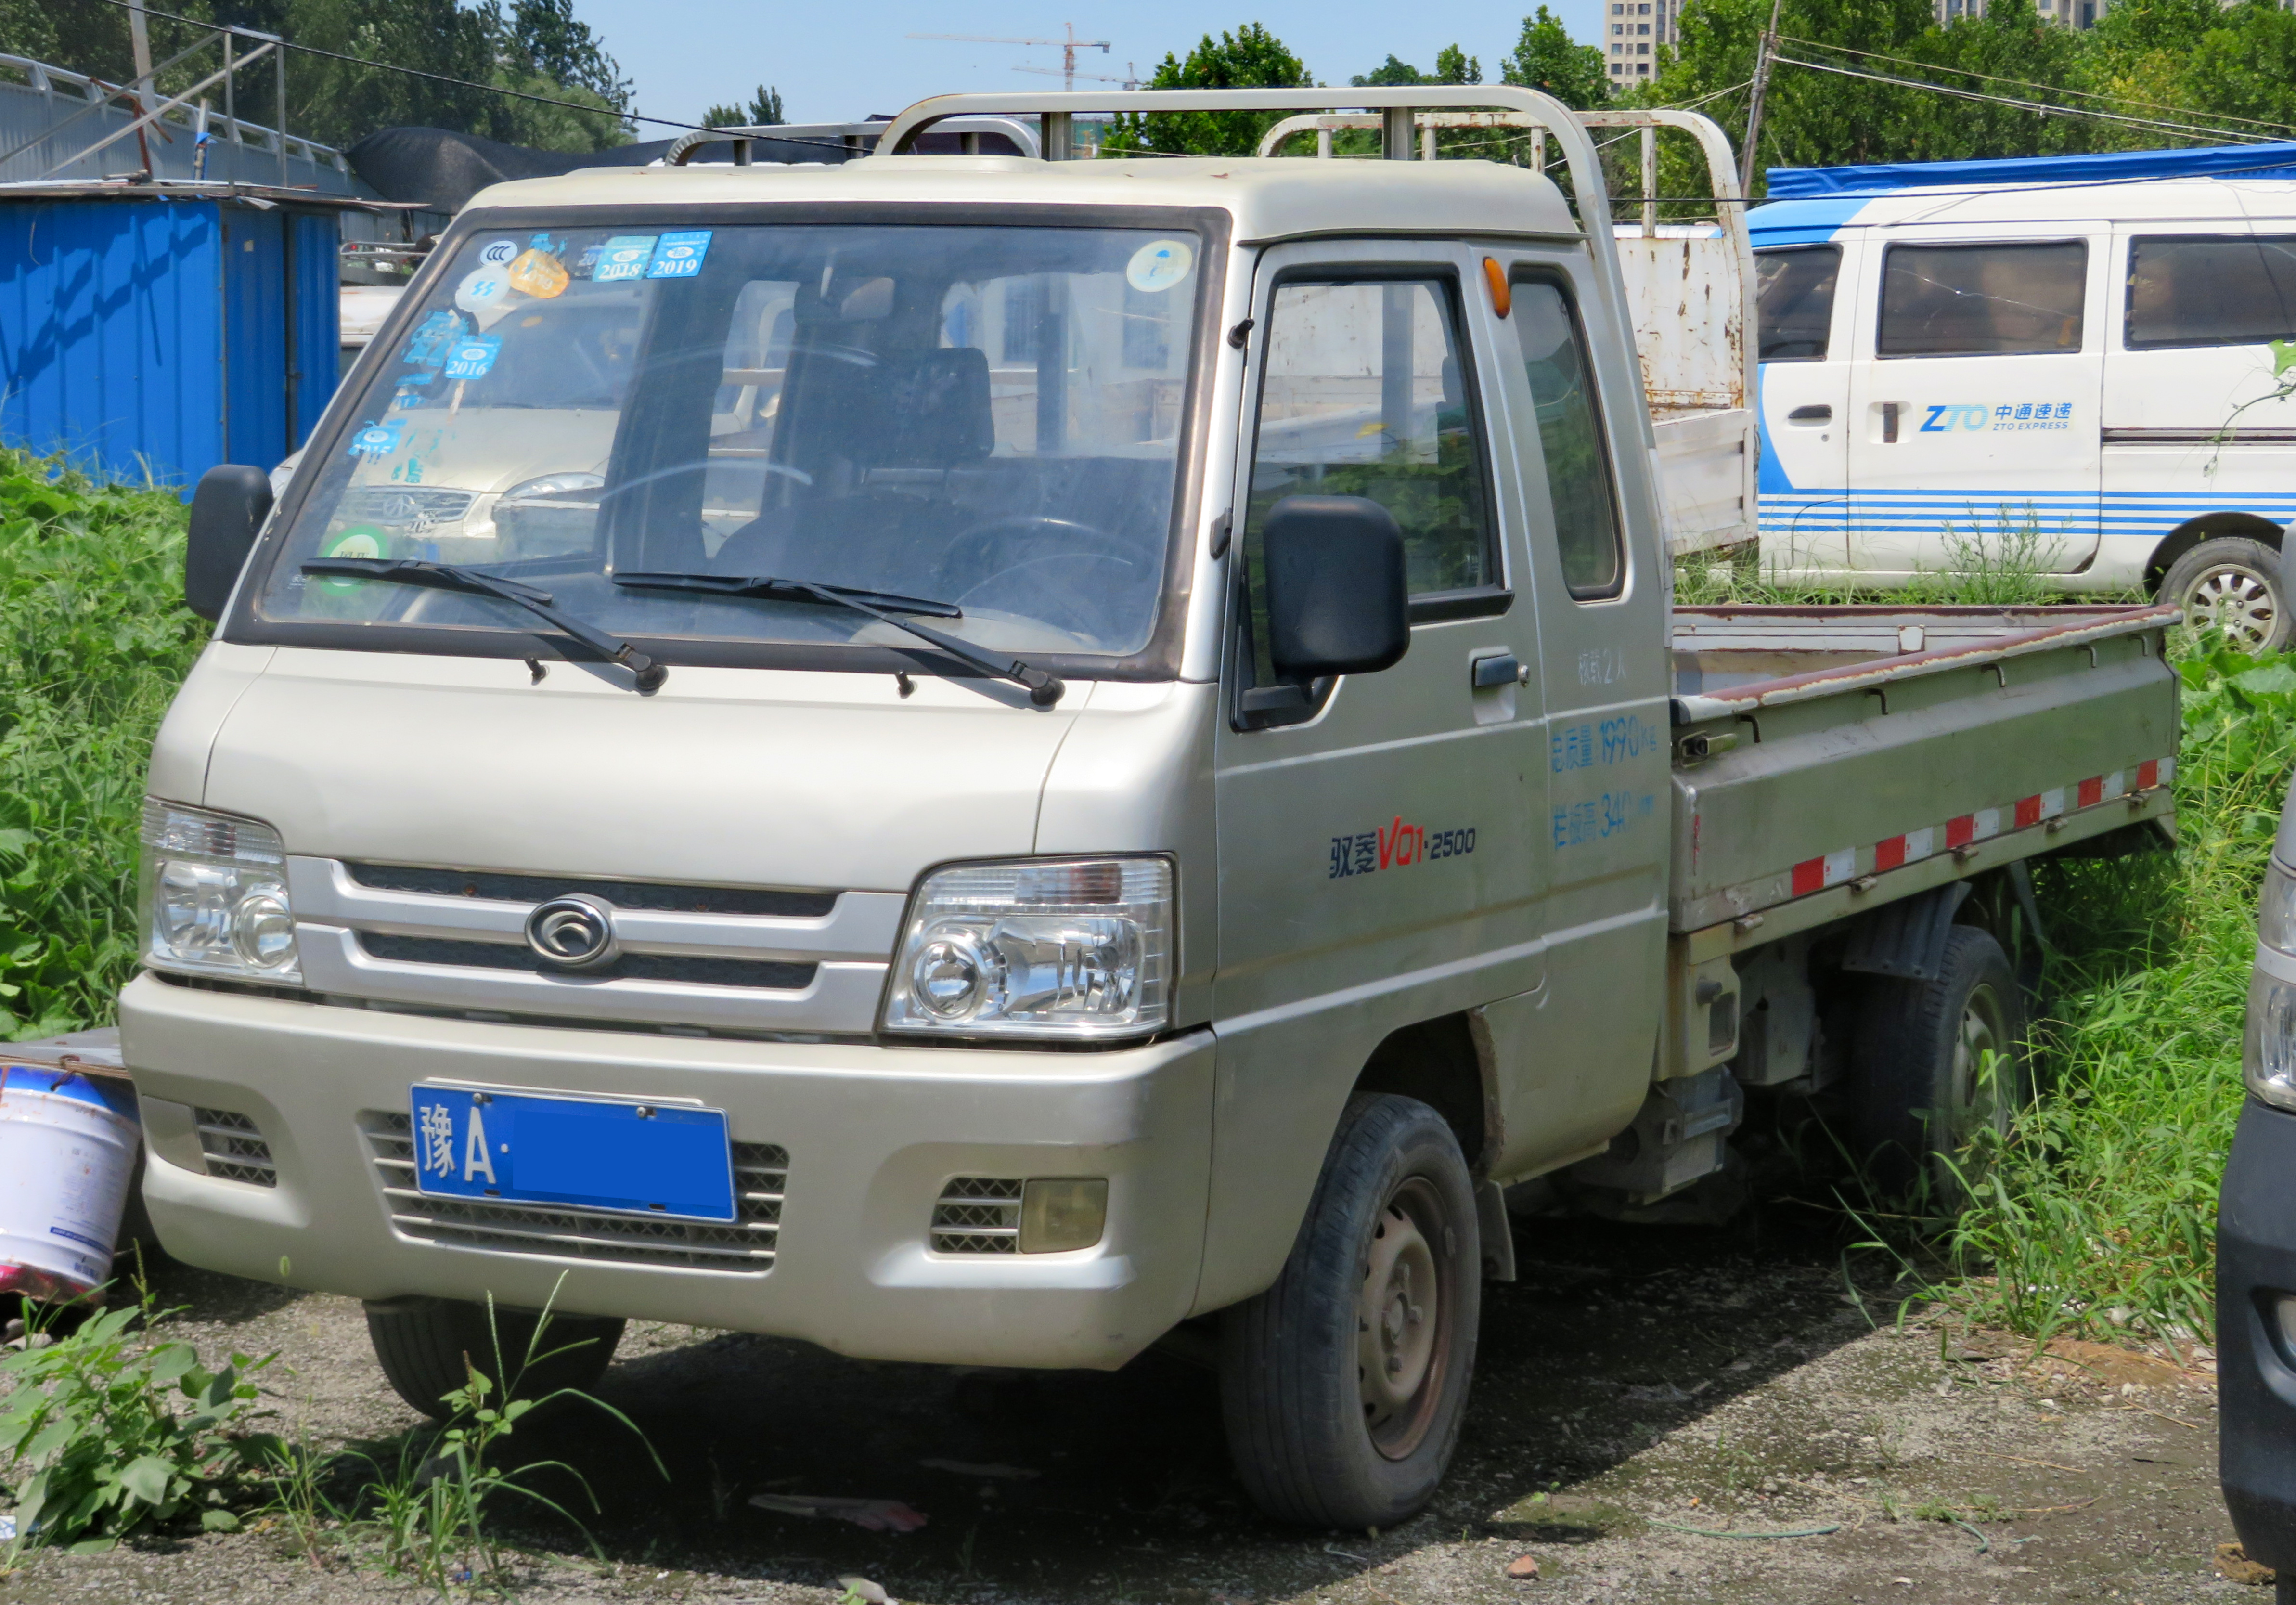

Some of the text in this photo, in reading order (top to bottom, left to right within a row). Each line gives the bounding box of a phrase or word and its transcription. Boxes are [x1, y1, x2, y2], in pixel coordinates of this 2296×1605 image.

[598, 263, 642, 279] 2018
[653, 259, 697, 275] 2019
[446, 361, 490, 375] 2016
[1919, 404, 1989, 432] ZTO
[1994, 402, 2072, 420] 中通速递
[1993, 422, 2068, 431] ZTO EXPRESS
